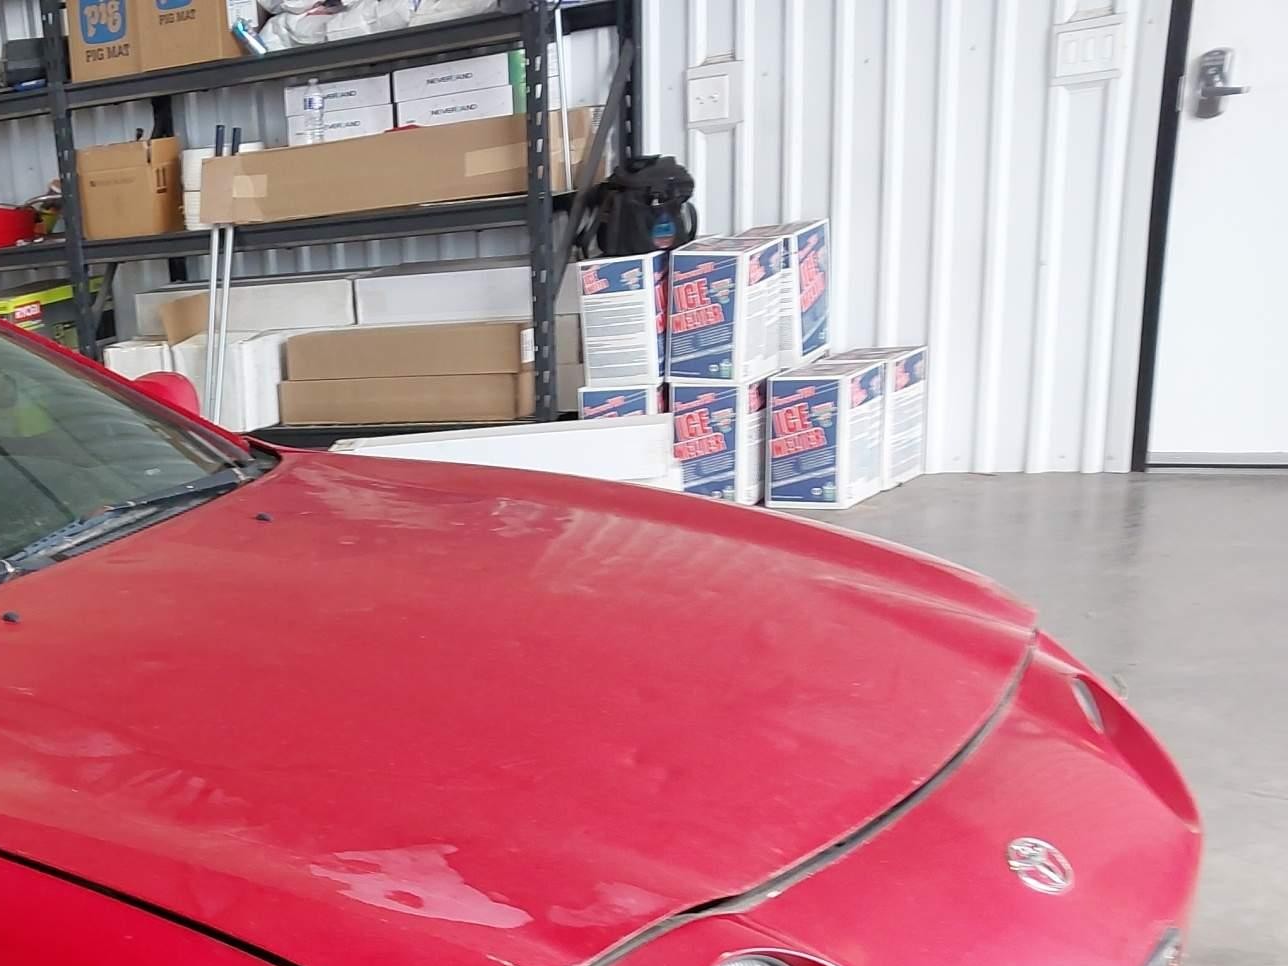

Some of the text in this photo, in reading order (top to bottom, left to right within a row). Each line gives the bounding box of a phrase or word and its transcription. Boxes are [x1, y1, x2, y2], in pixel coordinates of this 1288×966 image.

[159, 8, 197, 26] PIG MAT
[85, 43, 130, 63] PIG MAT
[672, 277, 712, 313] ICE
[675, 407, 713, 441] ICE
[771, 402, 813, 437] ICE
